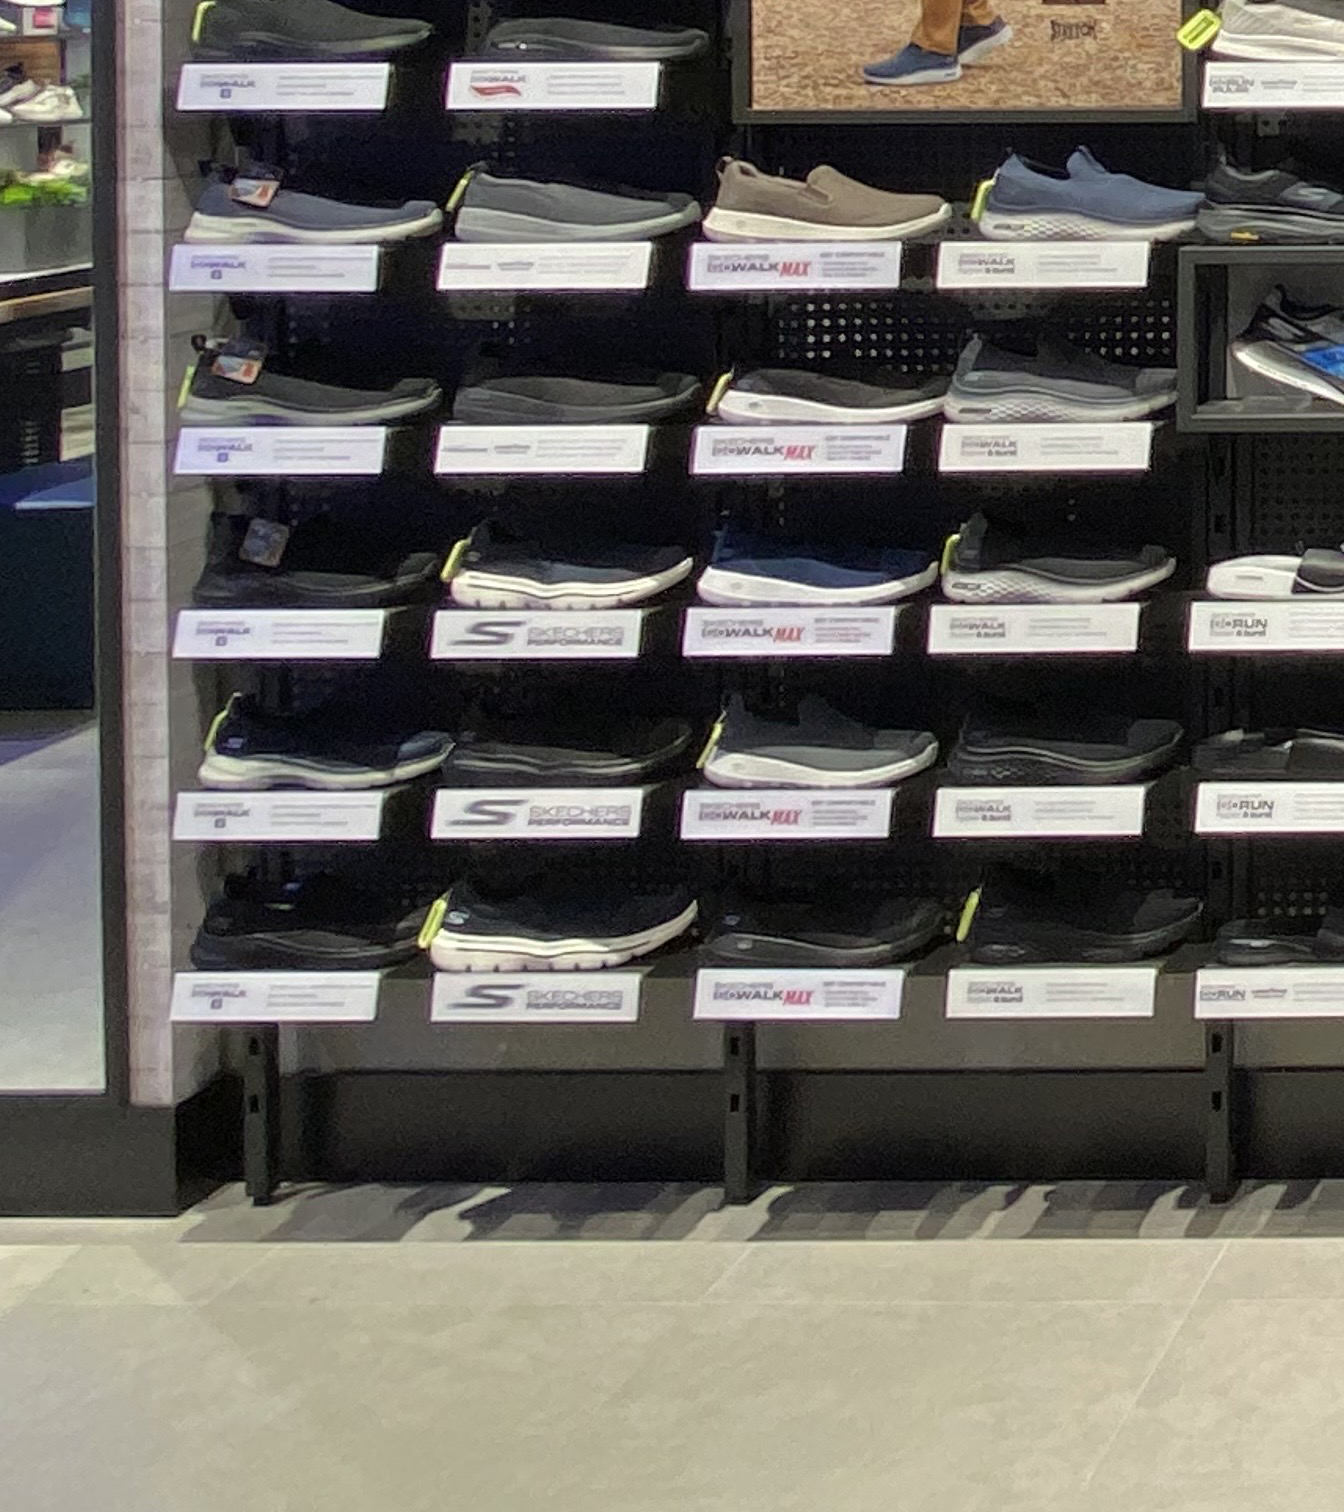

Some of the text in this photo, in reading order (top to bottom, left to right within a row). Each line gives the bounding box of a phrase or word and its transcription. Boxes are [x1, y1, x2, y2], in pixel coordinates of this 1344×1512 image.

[527, 626, 624, 639] SKECHERS
[529, 805, 632, 818] SKECHERS
[526, 989, 624, 1002] SKECHERS
